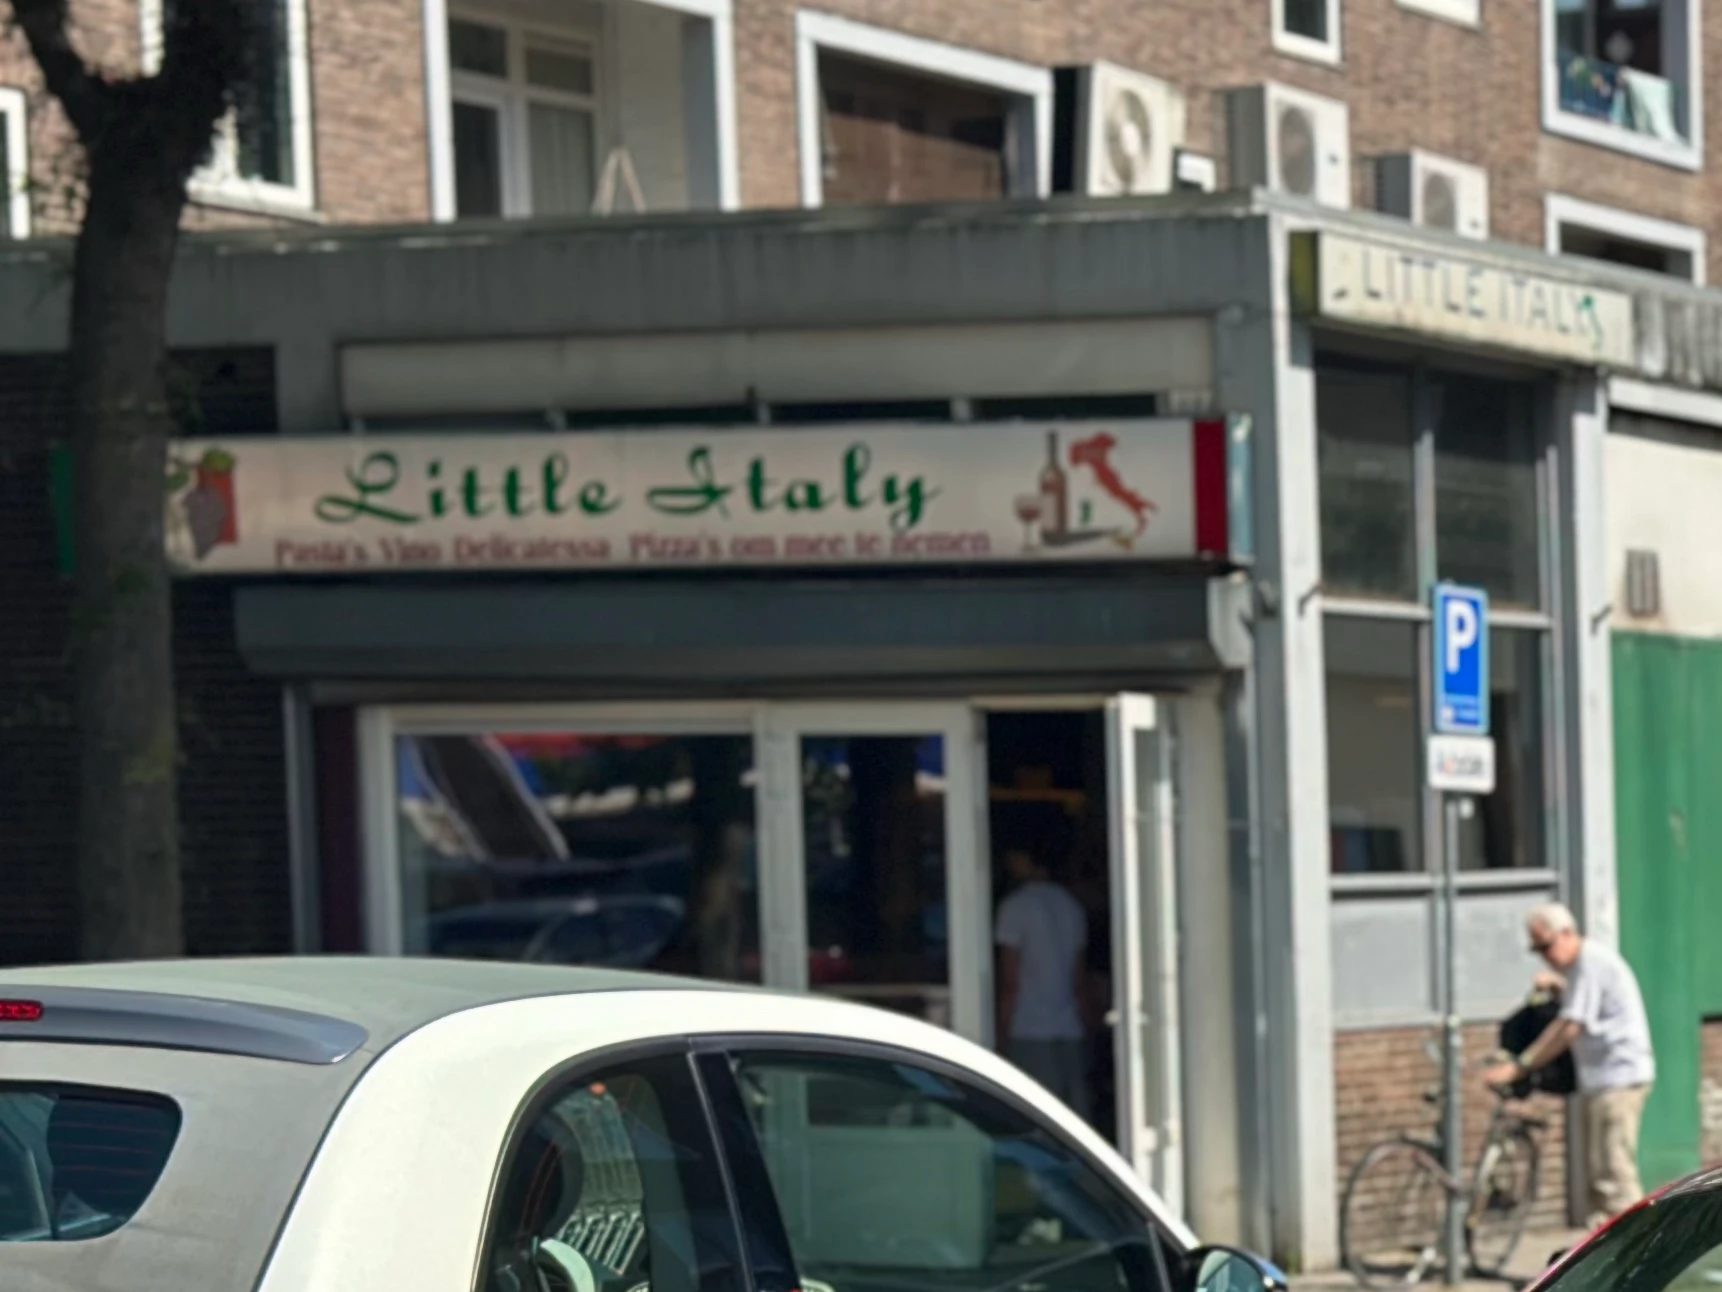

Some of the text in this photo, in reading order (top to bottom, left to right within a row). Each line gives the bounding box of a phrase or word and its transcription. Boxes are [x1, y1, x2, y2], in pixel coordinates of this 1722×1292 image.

[1362, 247, 1486, 320] LITTLE
[314, 442, 941, 529] Little Italy
[275, 537, 368, 566] Pasta's
[378, 536, 442, 563] Vino
[629, 530, 723, 562] Pizza's
[730, 534, 776, 557] om
[890, 530, 991, 556] nemen
[1446, 599, 1477, 675] P
